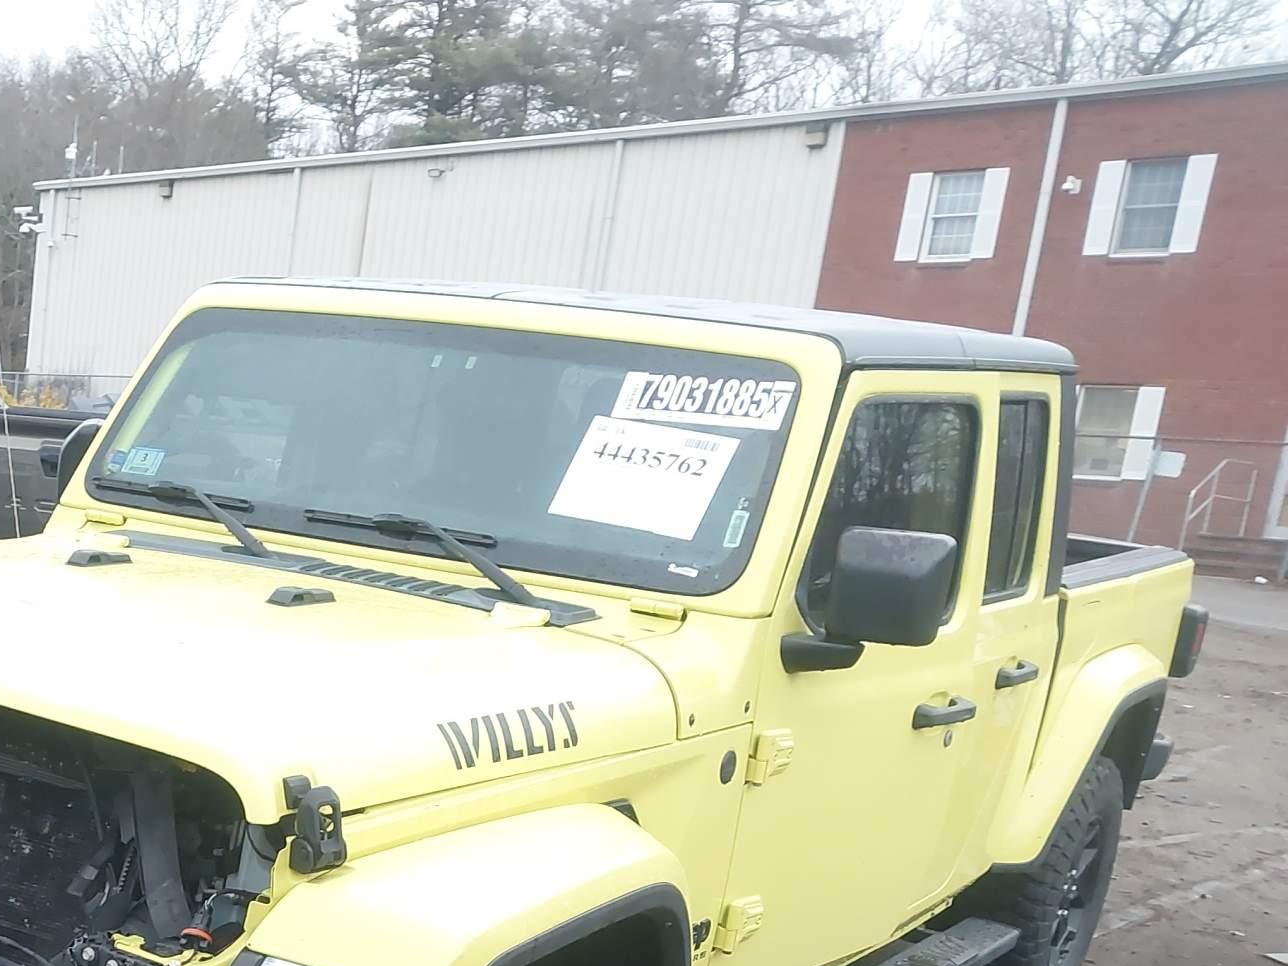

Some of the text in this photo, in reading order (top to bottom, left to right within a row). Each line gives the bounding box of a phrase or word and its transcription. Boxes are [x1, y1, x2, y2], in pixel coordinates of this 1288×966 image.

[637, 374, 775, 418] 79031885
[593, 441, 708, 477] 44435762
[436, 700, 579, 771] WILLYS
